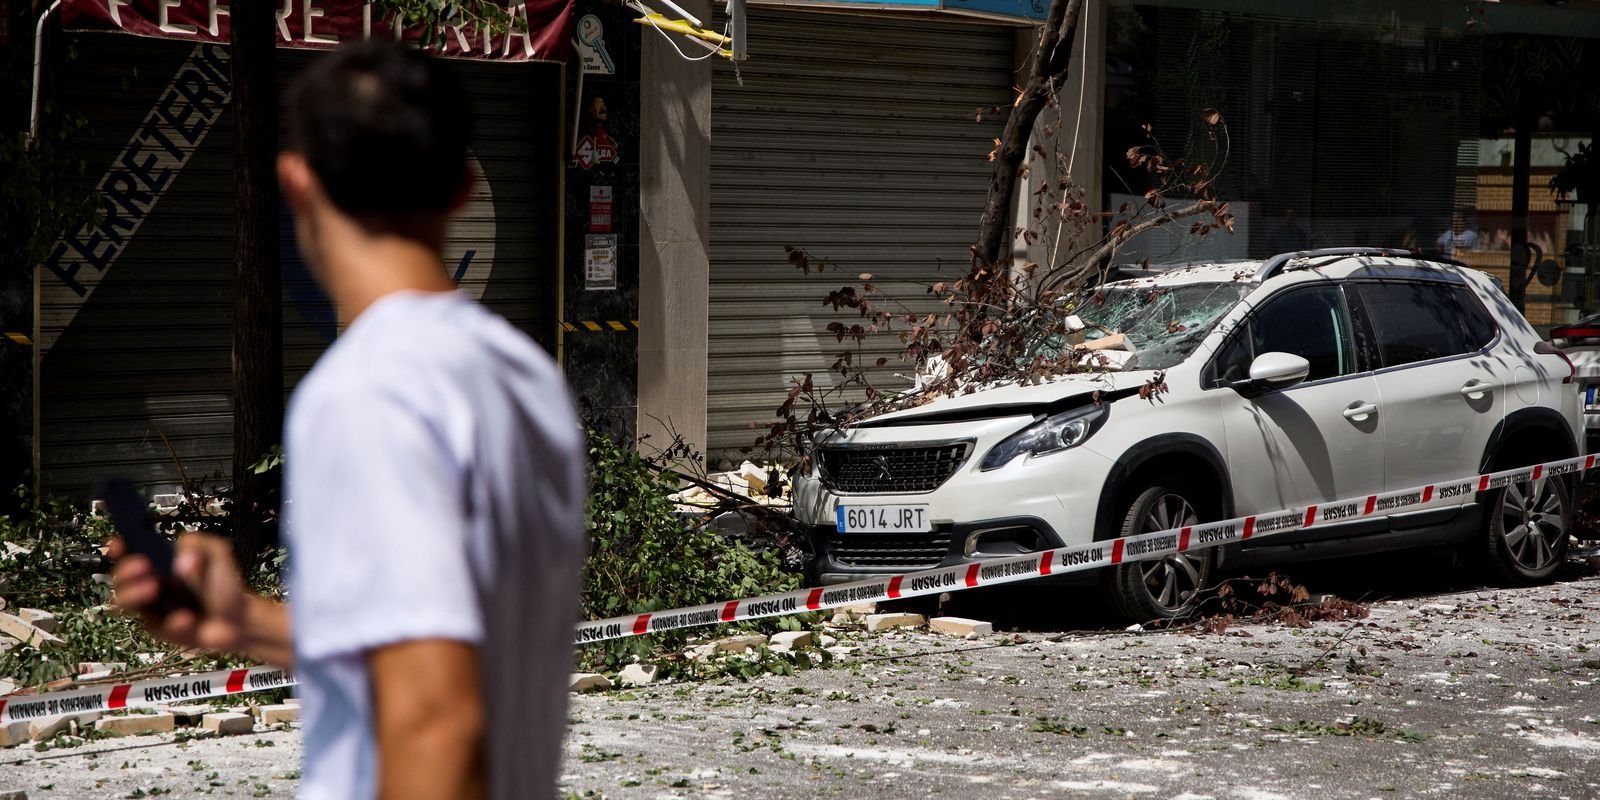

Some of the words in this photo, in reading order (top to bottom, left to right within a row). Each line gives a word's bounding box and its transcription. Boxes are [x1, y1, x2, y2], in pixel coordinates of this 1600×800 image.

[107, 0, 535, 57] FERERIA
[1439, 485, 1461, 499] PASAR
[1462, 482, 1471, 494] NO
[1323, 504, 1346, 520] PASAR
[1347, 503, 1358, 516] NO
[848, 508, 887, 529] 6014
[893, 508, 924, 529] JRT
[1198, 527, 1223, 543] PASAR
[1225, 524, 1236, 538] NO
[1126, 541, 1147, 556] GRANADA
[1147, 540, 1153, 552] DE
[1154, 535, 1177, 551] BOMBEROS
[1062, 550, 1089, 566] PASAR
[1091, 547, 1103, 561] NO
[981, 564, 1004, 580] GRANADA
[1005, 562, 1011, 576] DE
[1011, 559, 1037, 575] BOMBEROS
[911, 574, 940, 591] PASAR
[943, 572, 956, 586] NO
[824, 589, 848, 605] GRANADA
[849, 587, 856, 601] DE
[856, 583, 885, 599] BOMBEROS
[748, 599, 780, 616] PASAR
[782, 597, 796, 611] NO
[651, 614, 678, 630] GRANADA
[679, 613, 687, 624] DE
[687, 609, 718, 625] BOMBEROS
[574, 625, 603, 642] PASA
[606, 623, 621, 636] NO
[144, 682, 189, 702] PASAR
[192, 679, 211, 695] NO
[9, 701, 47, 720] GRANADA
[48, 699, 59, 715] DE
[60, 694, 104, 713] BOMBEROS
